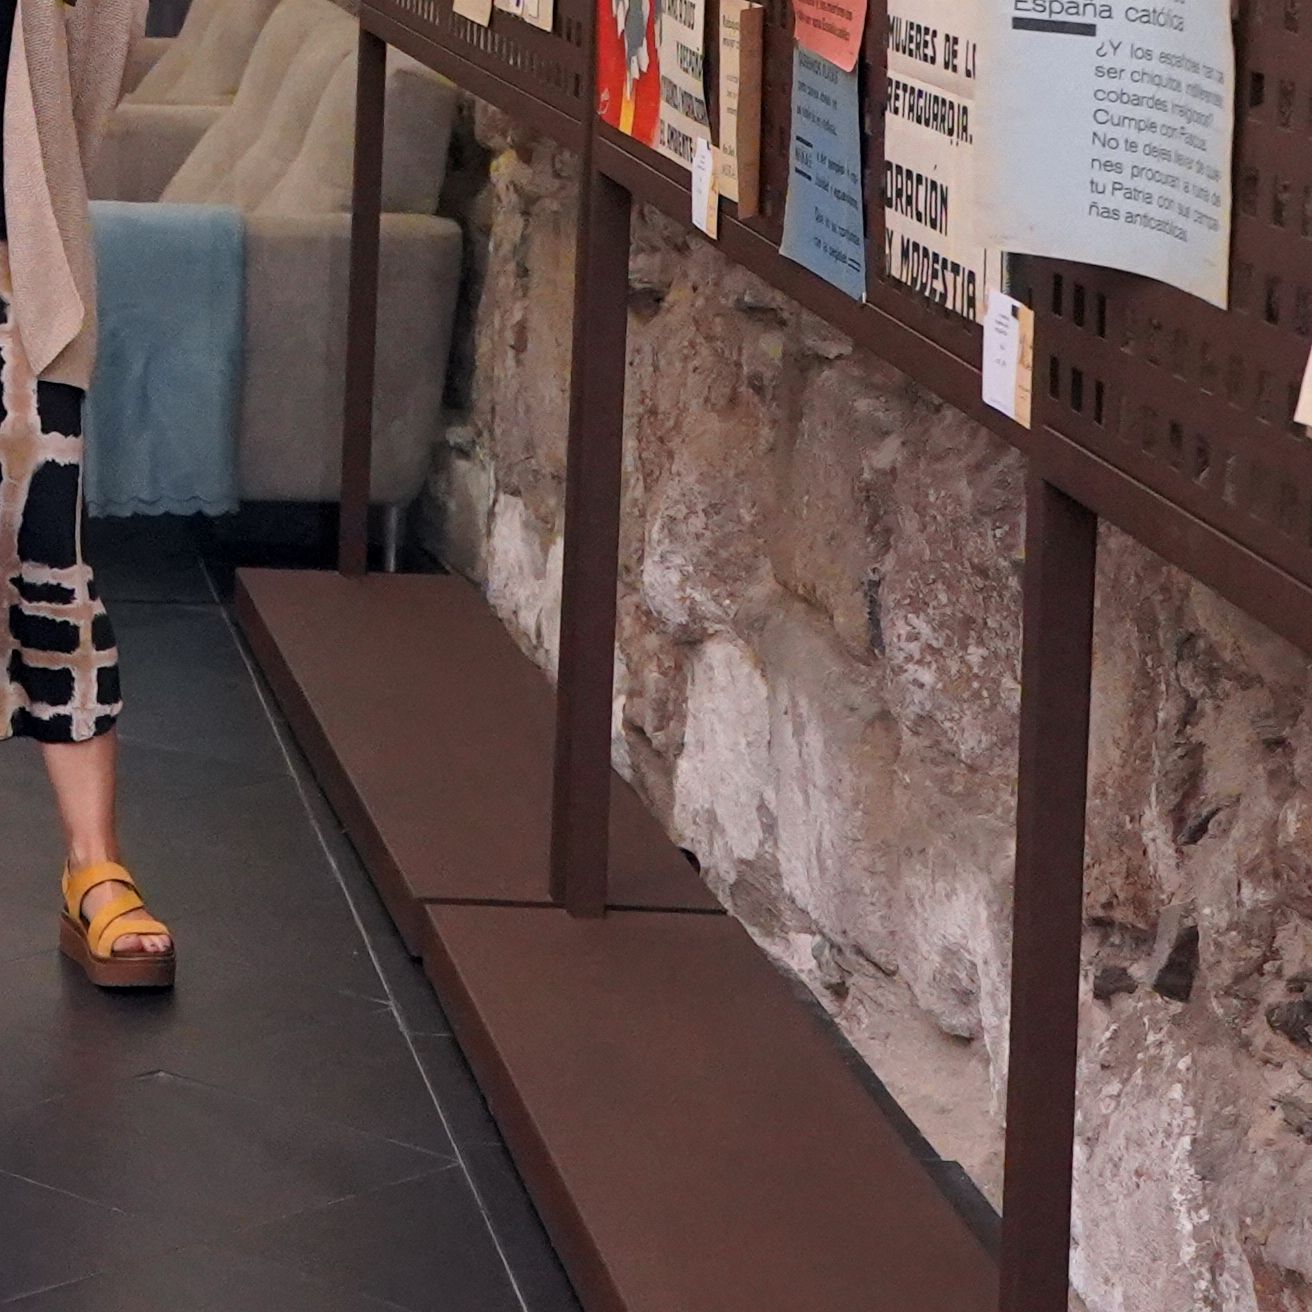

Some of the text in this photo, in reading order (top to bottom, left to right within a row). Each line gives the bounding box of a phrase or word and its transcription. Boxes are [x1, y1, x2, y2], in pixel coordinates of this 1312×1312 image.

[1125, 6, 1184, 32] católica
[887, 14, 959, 74] MUJERES DE
[1096, 39, 1153, 61] ¿Y los
[1094, 65, 1125, 80] ser
[1093, 108, 1157, 133] Cumple
[1092, 131, 1119, 150] No
[1124, 138, 1138, 153] te
[1091, 158, 1123, 174] nes
[1089, 178, 1175, 210] tu Patria con
[1088, 201, 1120, 221] ñas
[885, 227, 976, 321] Y MODESTIA
